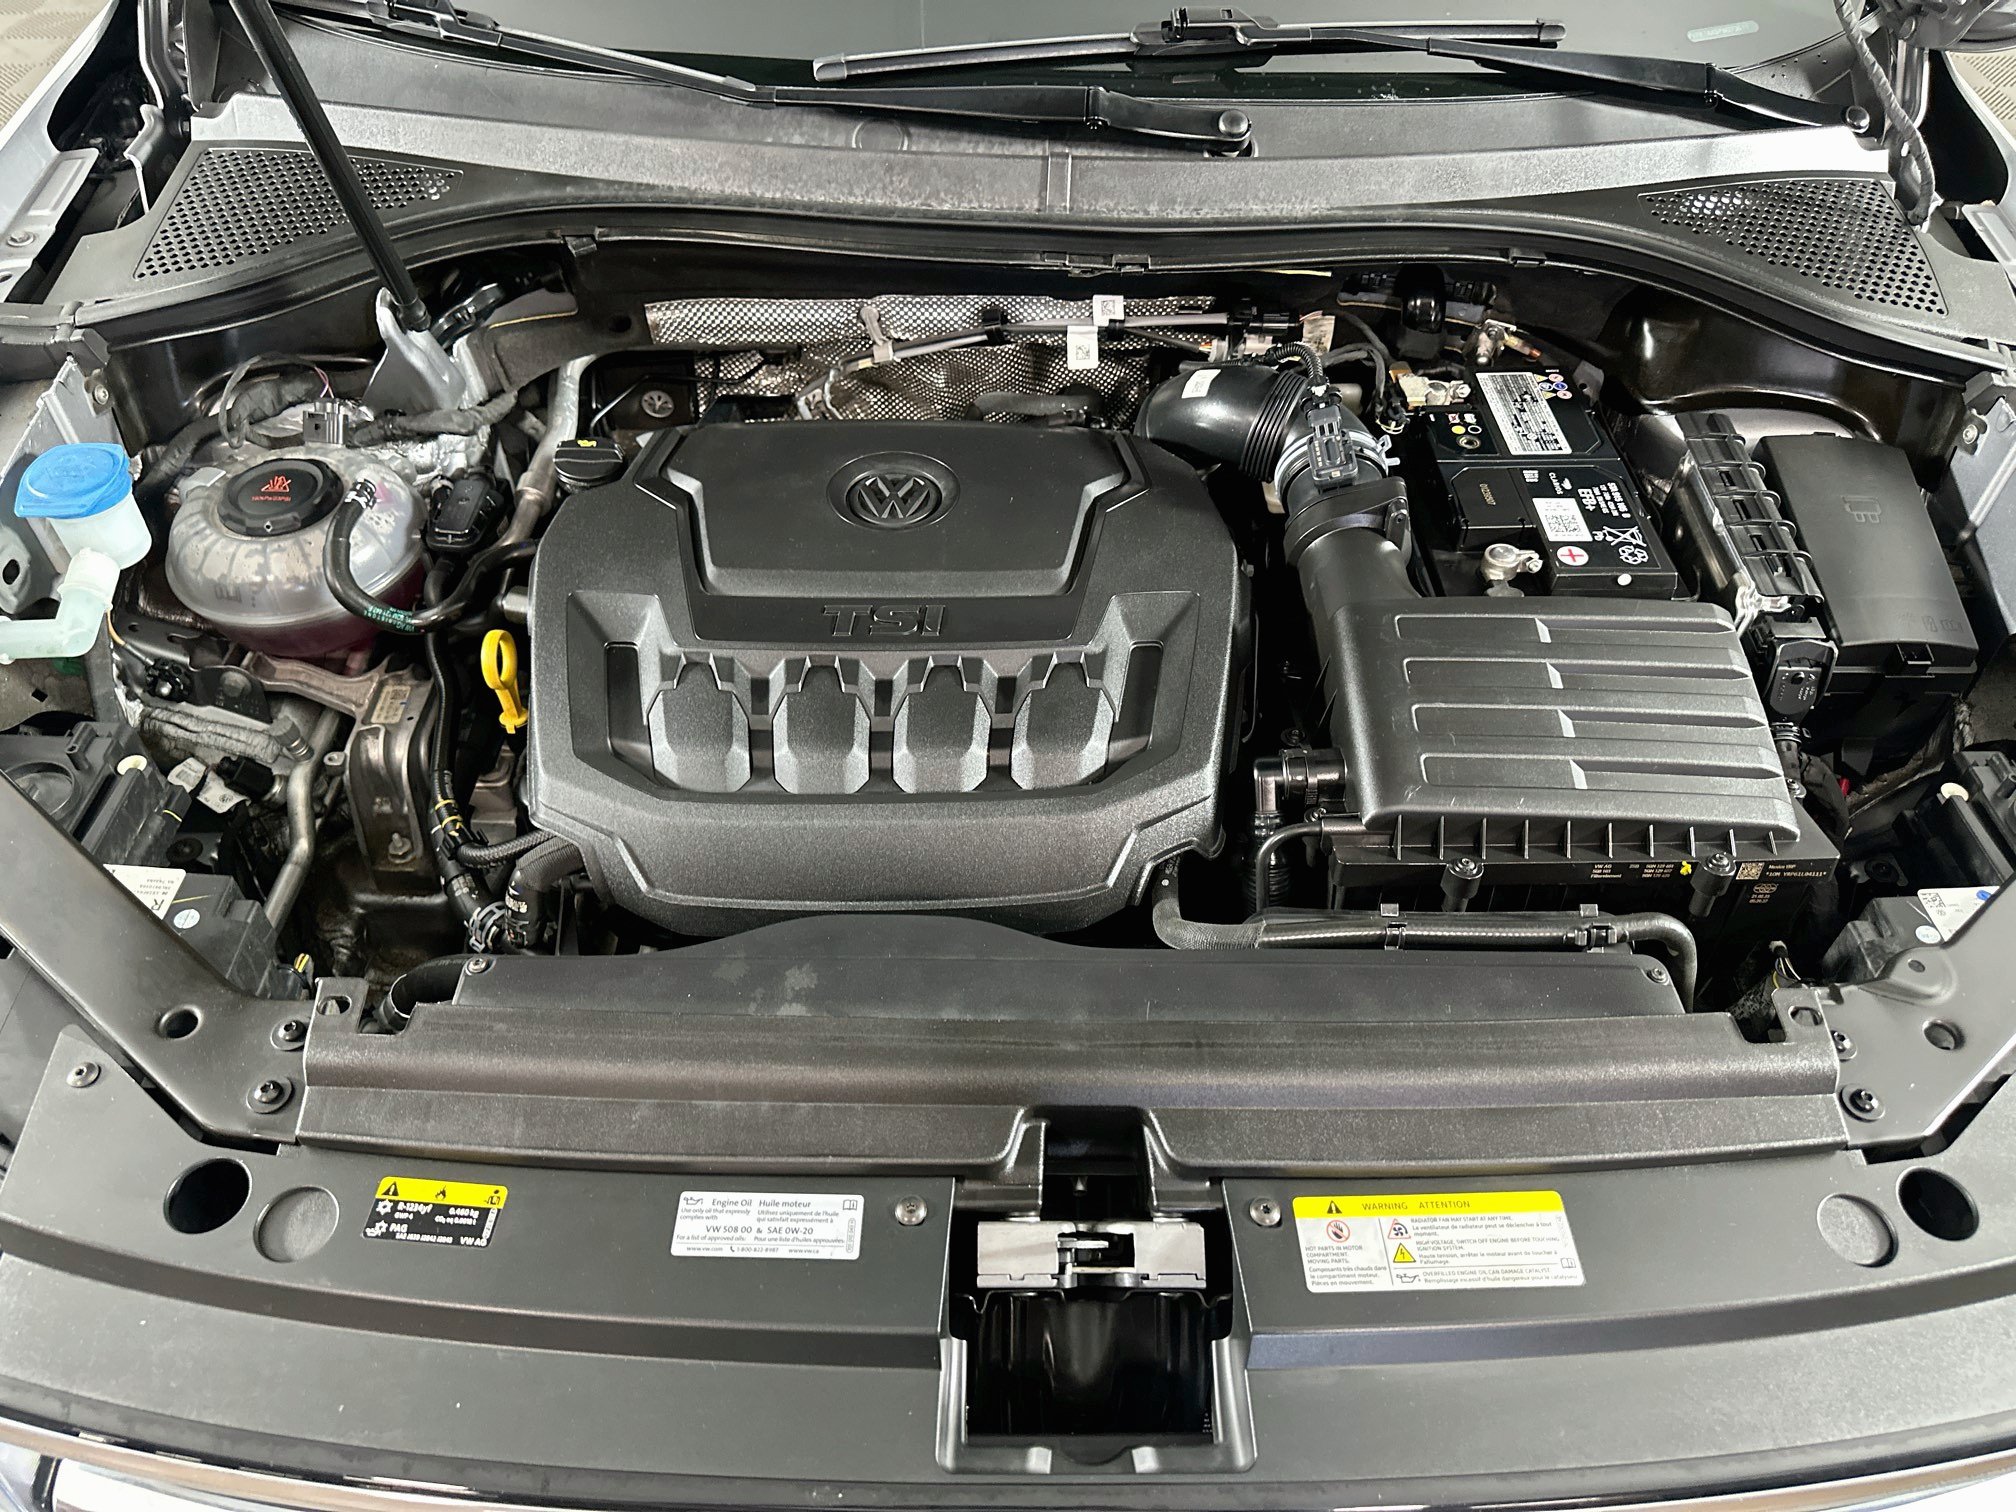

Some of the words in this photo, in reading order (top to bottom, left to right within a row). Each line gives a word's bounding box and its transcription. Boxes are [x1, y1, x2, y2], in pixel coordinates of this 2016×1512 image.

[823, 604, 946, 636] TSI
[150, 898, 165, 911] R
[712, 1199, 738, 1208] Engine
[1362, 1202, 1408, 1210] WARNING
[1419, 1200, 1471, 1209] ATTENTION
[389, 1224, 408, 1232] PAG
[460, 1237, 474, 1245] VW
[474, 1238, 487, 1246] AG
